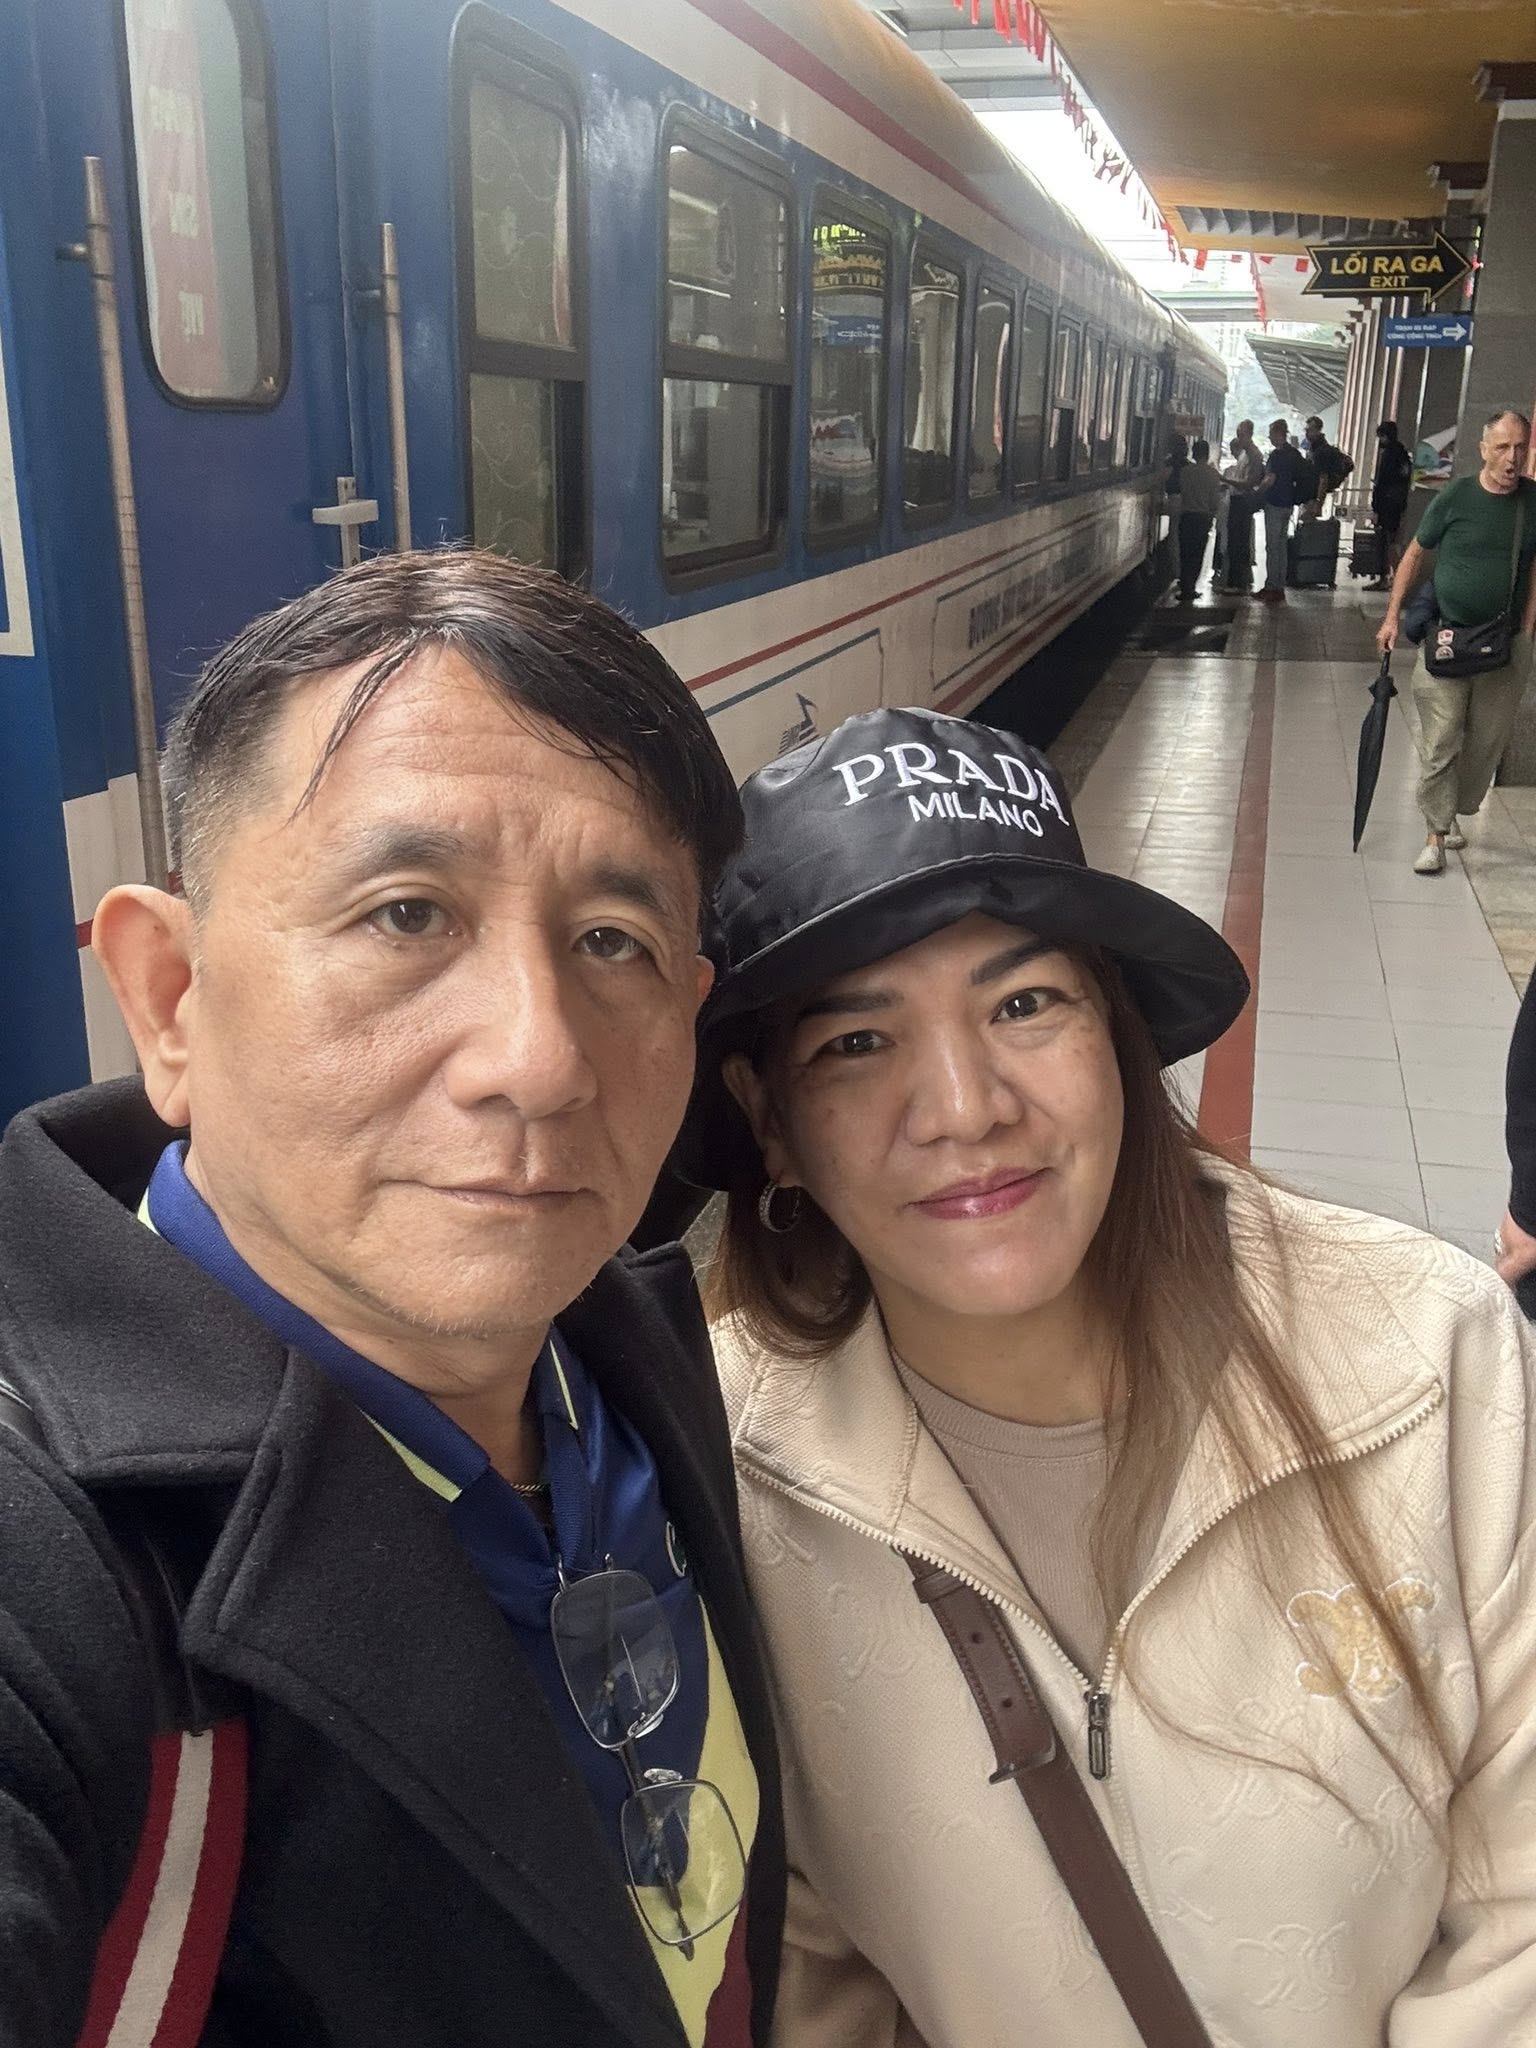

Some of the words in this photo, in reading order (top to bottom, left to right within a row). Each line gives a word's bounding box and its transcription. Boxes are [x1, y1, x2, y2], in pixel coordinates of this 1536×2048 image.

[1331, 251, 1368, 274] LỐI
[1373, 255, 1406, 274] RA
[1410, 255, 1444, 273] GA
[1369, 275, 1409, 288] EXIT
[831, 742, 1070, 827] PRADA
[907, 791, 1044, 838] MILANO
